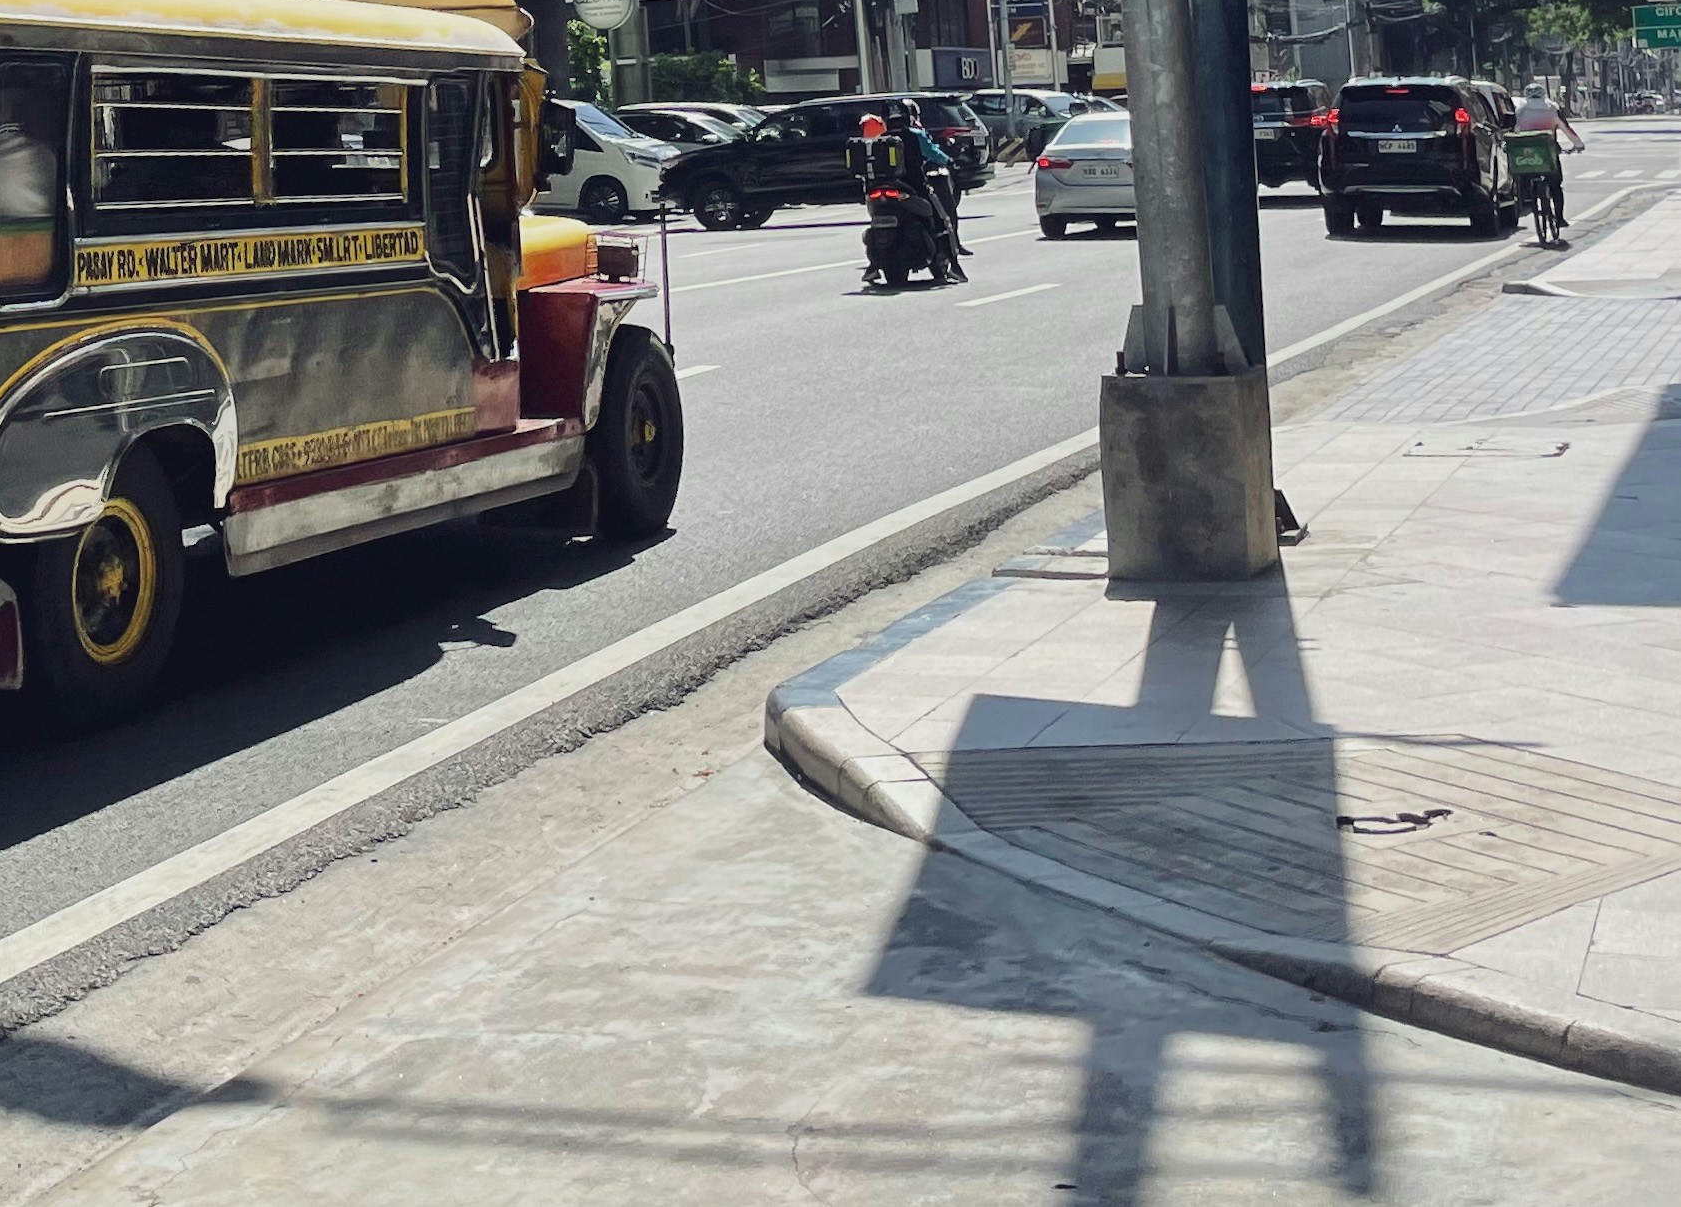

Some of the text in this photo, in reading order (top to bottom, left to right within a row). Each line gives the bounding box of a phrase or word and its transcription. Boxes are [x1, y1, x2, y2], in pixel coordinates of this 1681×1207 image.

[961, 57, 979, 80] BDO
[1515, 156, 1544, 167] Grab
[77, 250, 115, 282] PASAY
[117, 249, 140, 279] RD.
[145, 243, 198, 277] WALTER
[200, 242, 239, 273] MART
[364, 231, 419, 260] LIBERTAD
